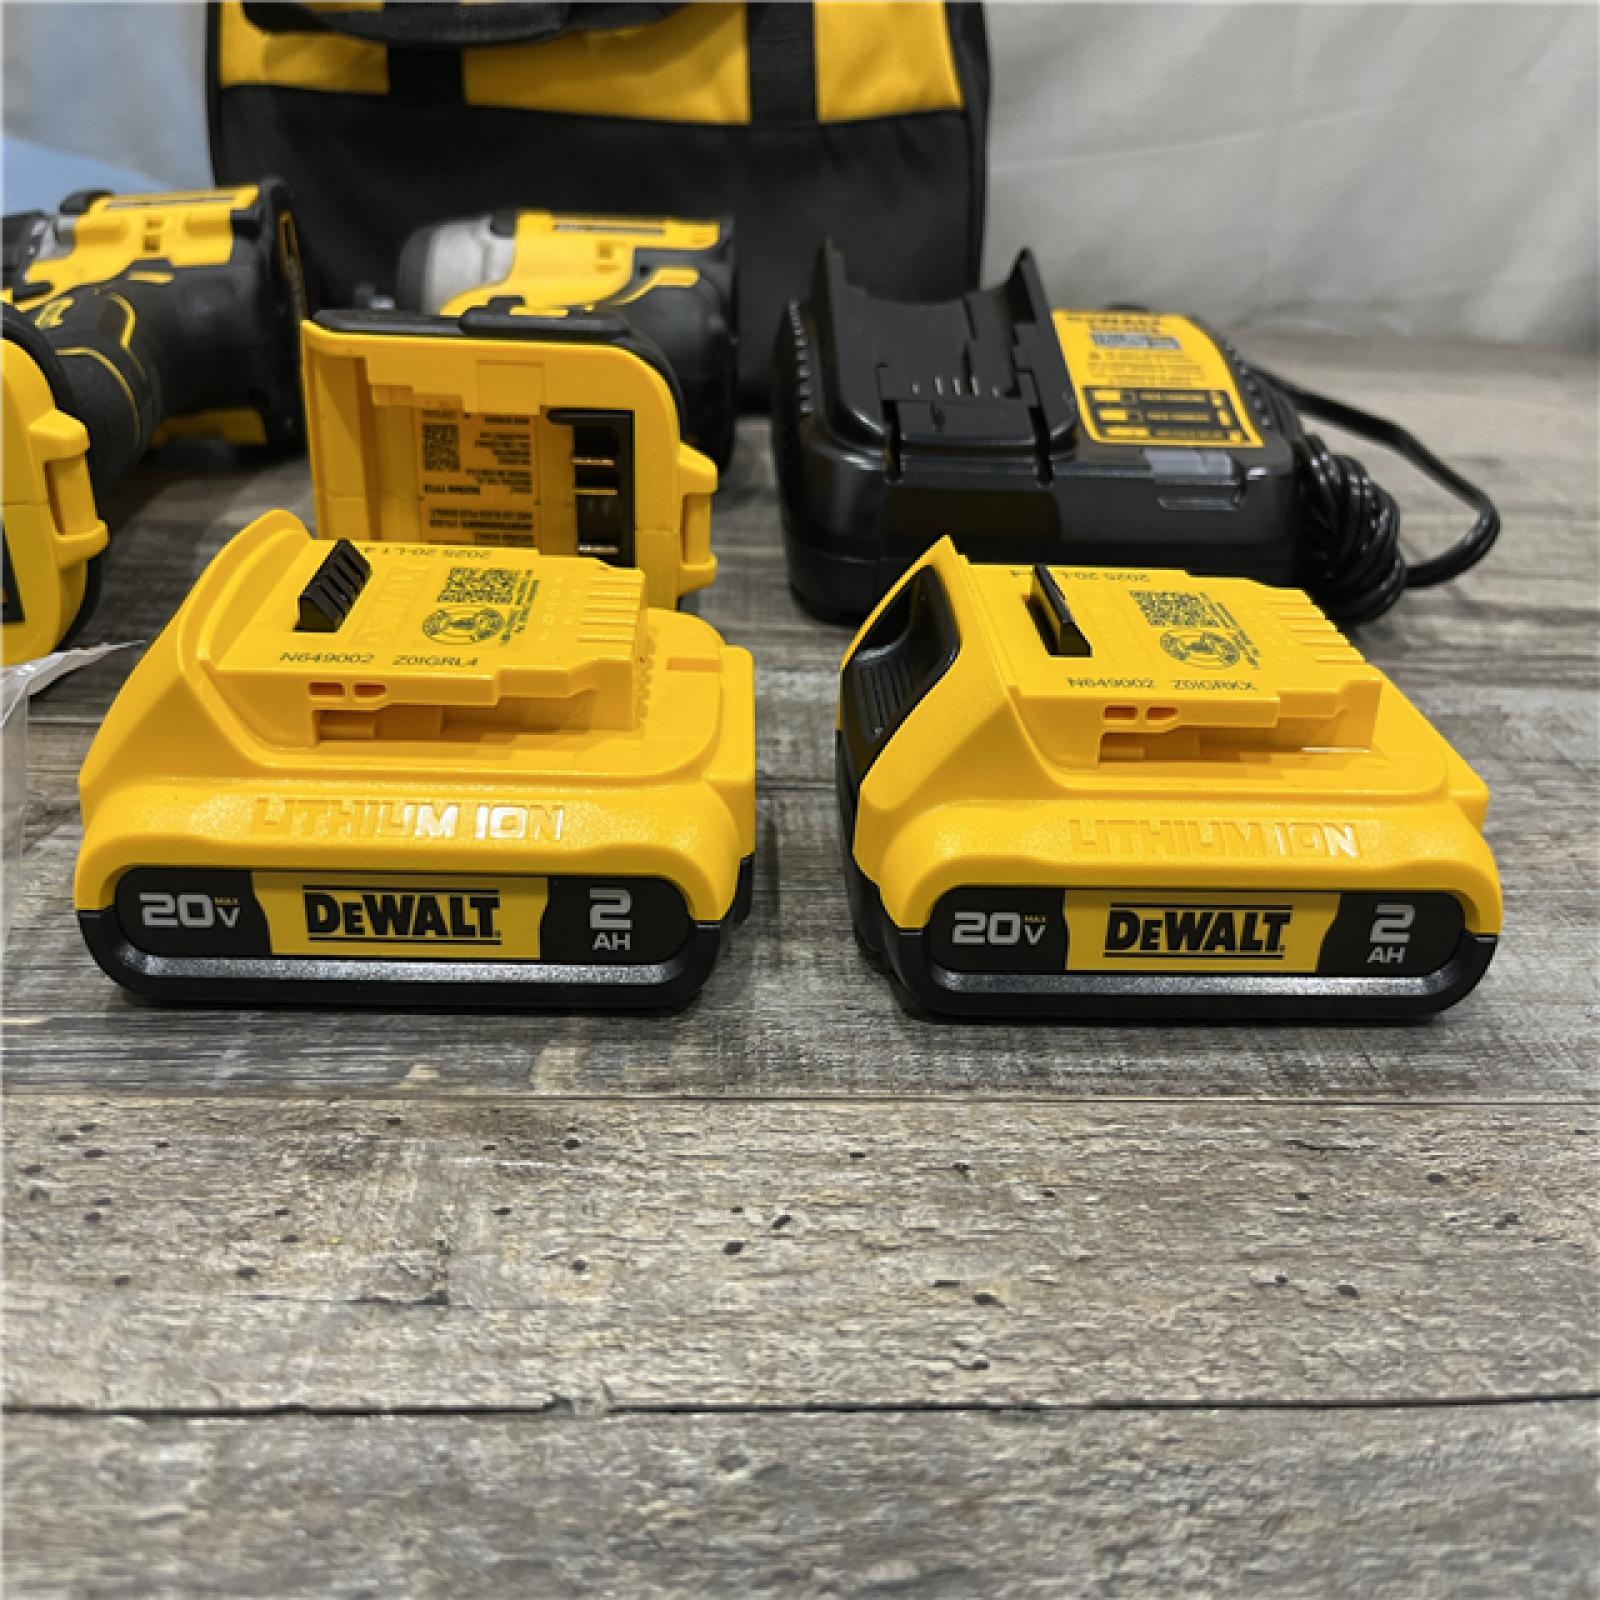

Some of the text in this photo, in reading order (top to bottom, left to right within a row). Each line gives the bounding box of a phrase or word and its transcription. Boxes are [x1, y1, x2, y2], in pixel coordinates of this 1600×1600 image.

[247, 797, 565, 842] LITHIUM ION
[1069, 818, 1361, 859] LITHIUM ION
[589, 887, 633, 931] 2
[1369, 904, 1416, 944] 2
[592, 931, 632, 951] AH
[1366, 946, 1406, 964] AH
